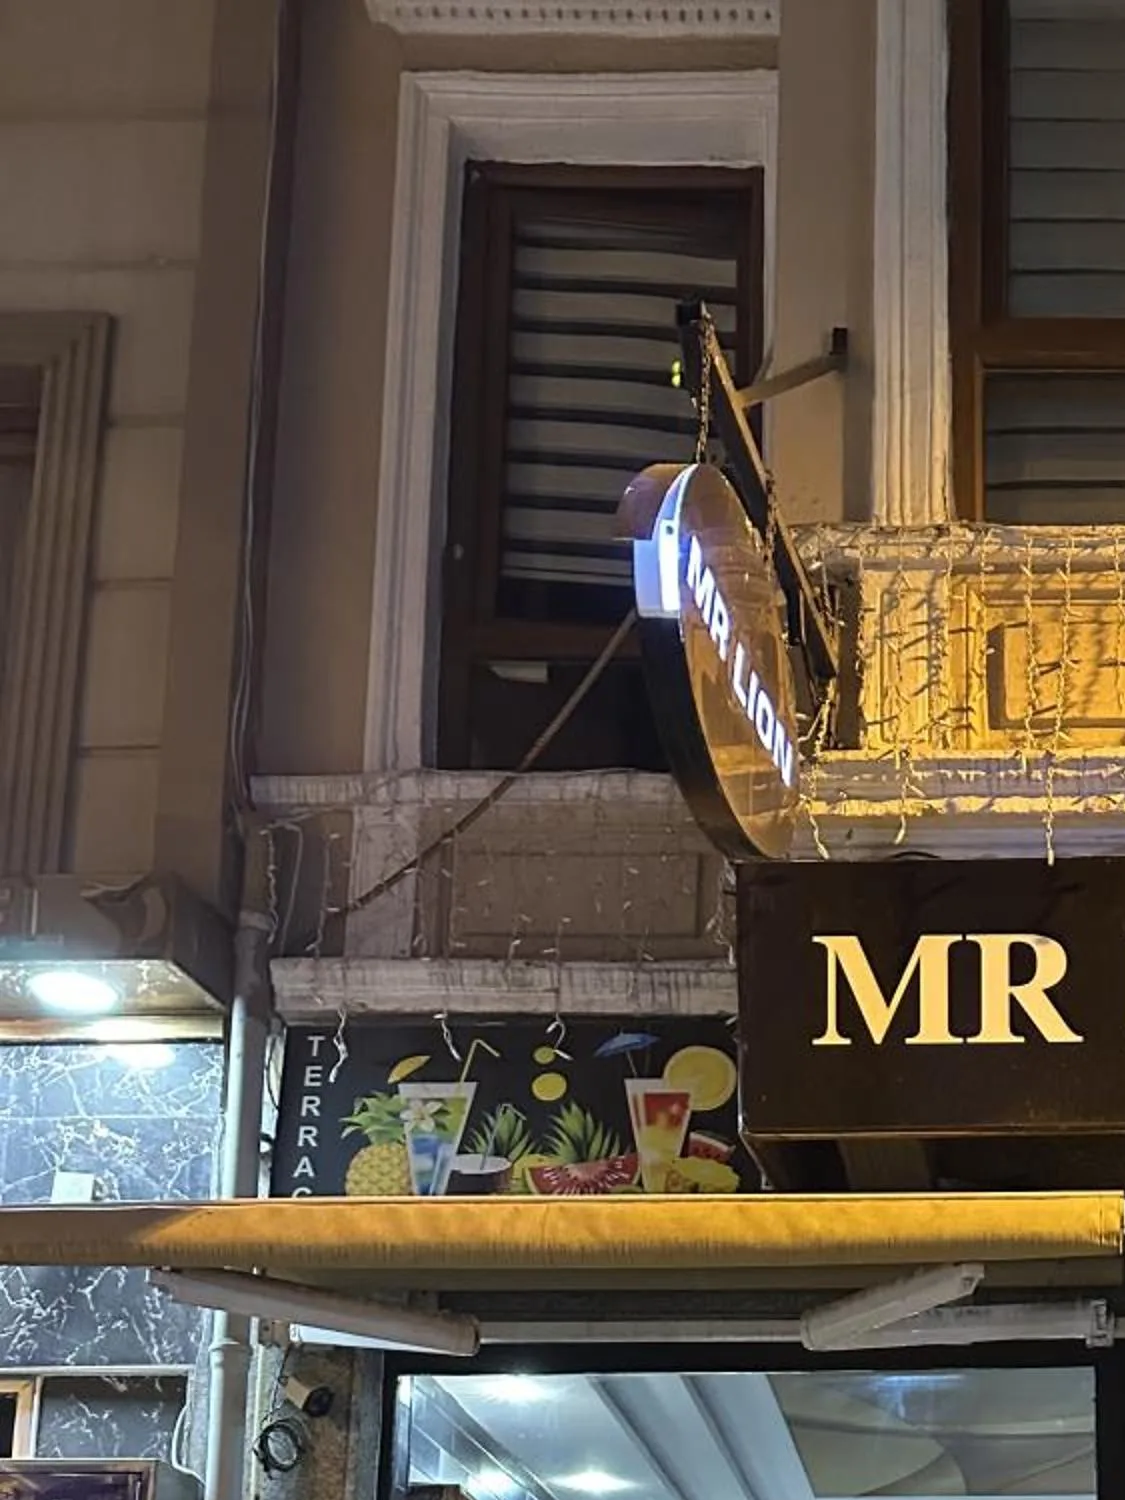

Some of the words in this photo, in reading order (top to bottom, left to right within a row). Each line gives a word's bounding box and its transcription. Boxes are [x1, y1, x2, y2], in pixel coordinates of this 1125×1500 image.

[685, 535, 732, 661] MR
[733, 649, 795, 788] LION
[811, 933, 1084, 1047] MR
